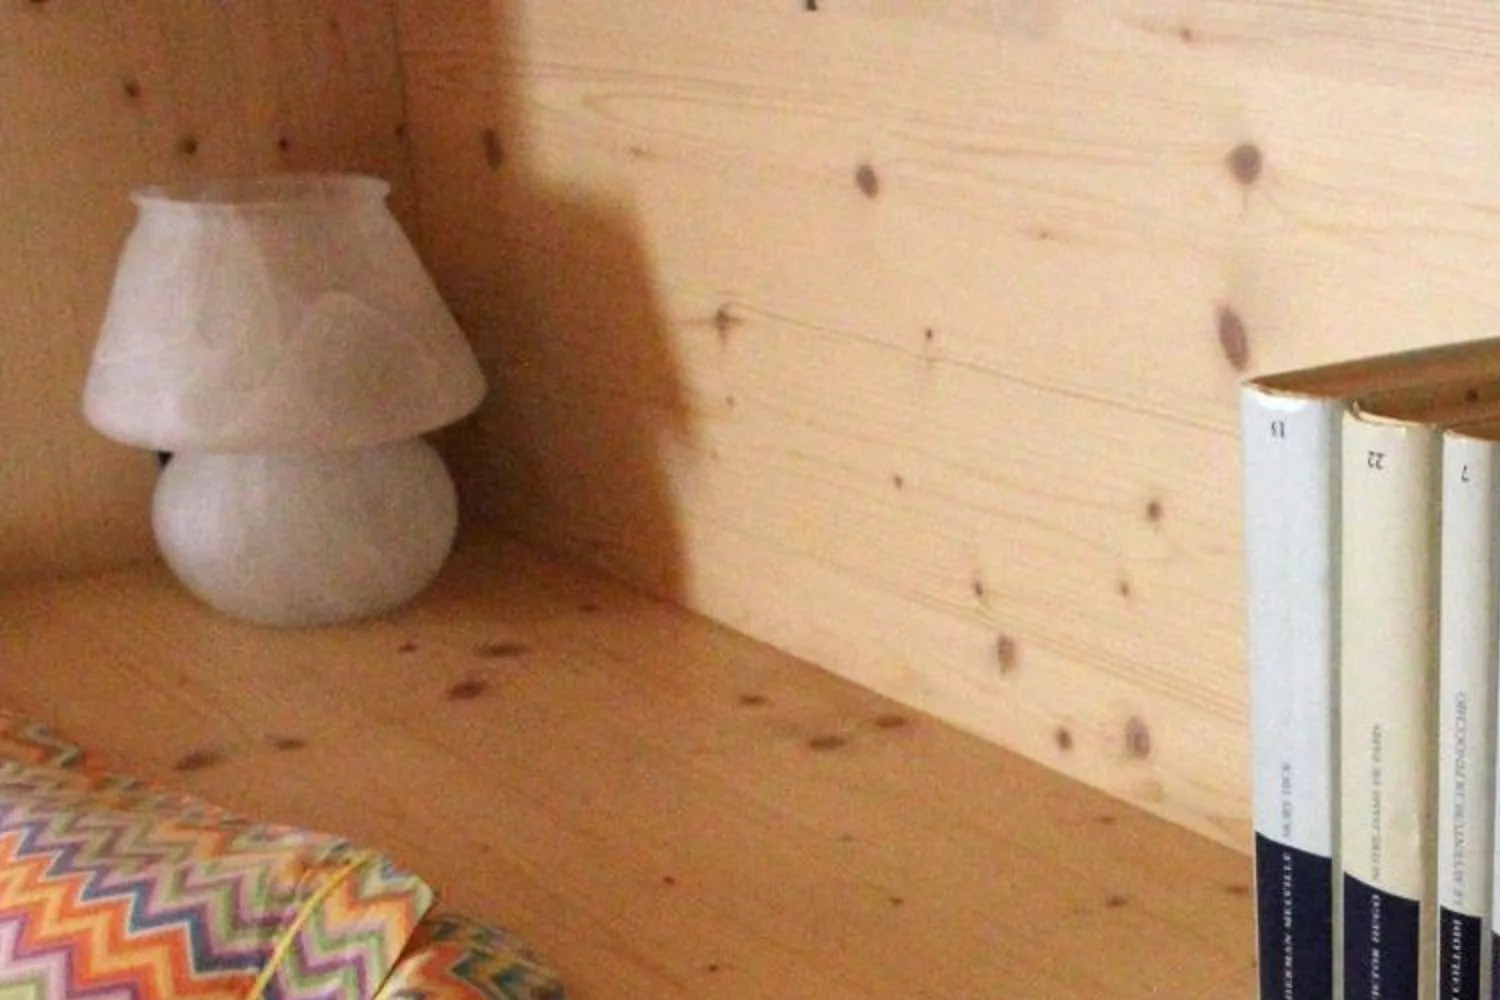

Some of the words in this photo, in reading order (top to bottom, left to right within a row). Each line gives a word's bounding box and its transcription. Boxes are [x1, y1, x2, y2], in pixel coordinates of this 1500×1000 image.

[1366, 448, 1385, 469] 22
[1371, 892, 1380, 942] HUGO
[1450, 919, 1462, 992] COLLODI
